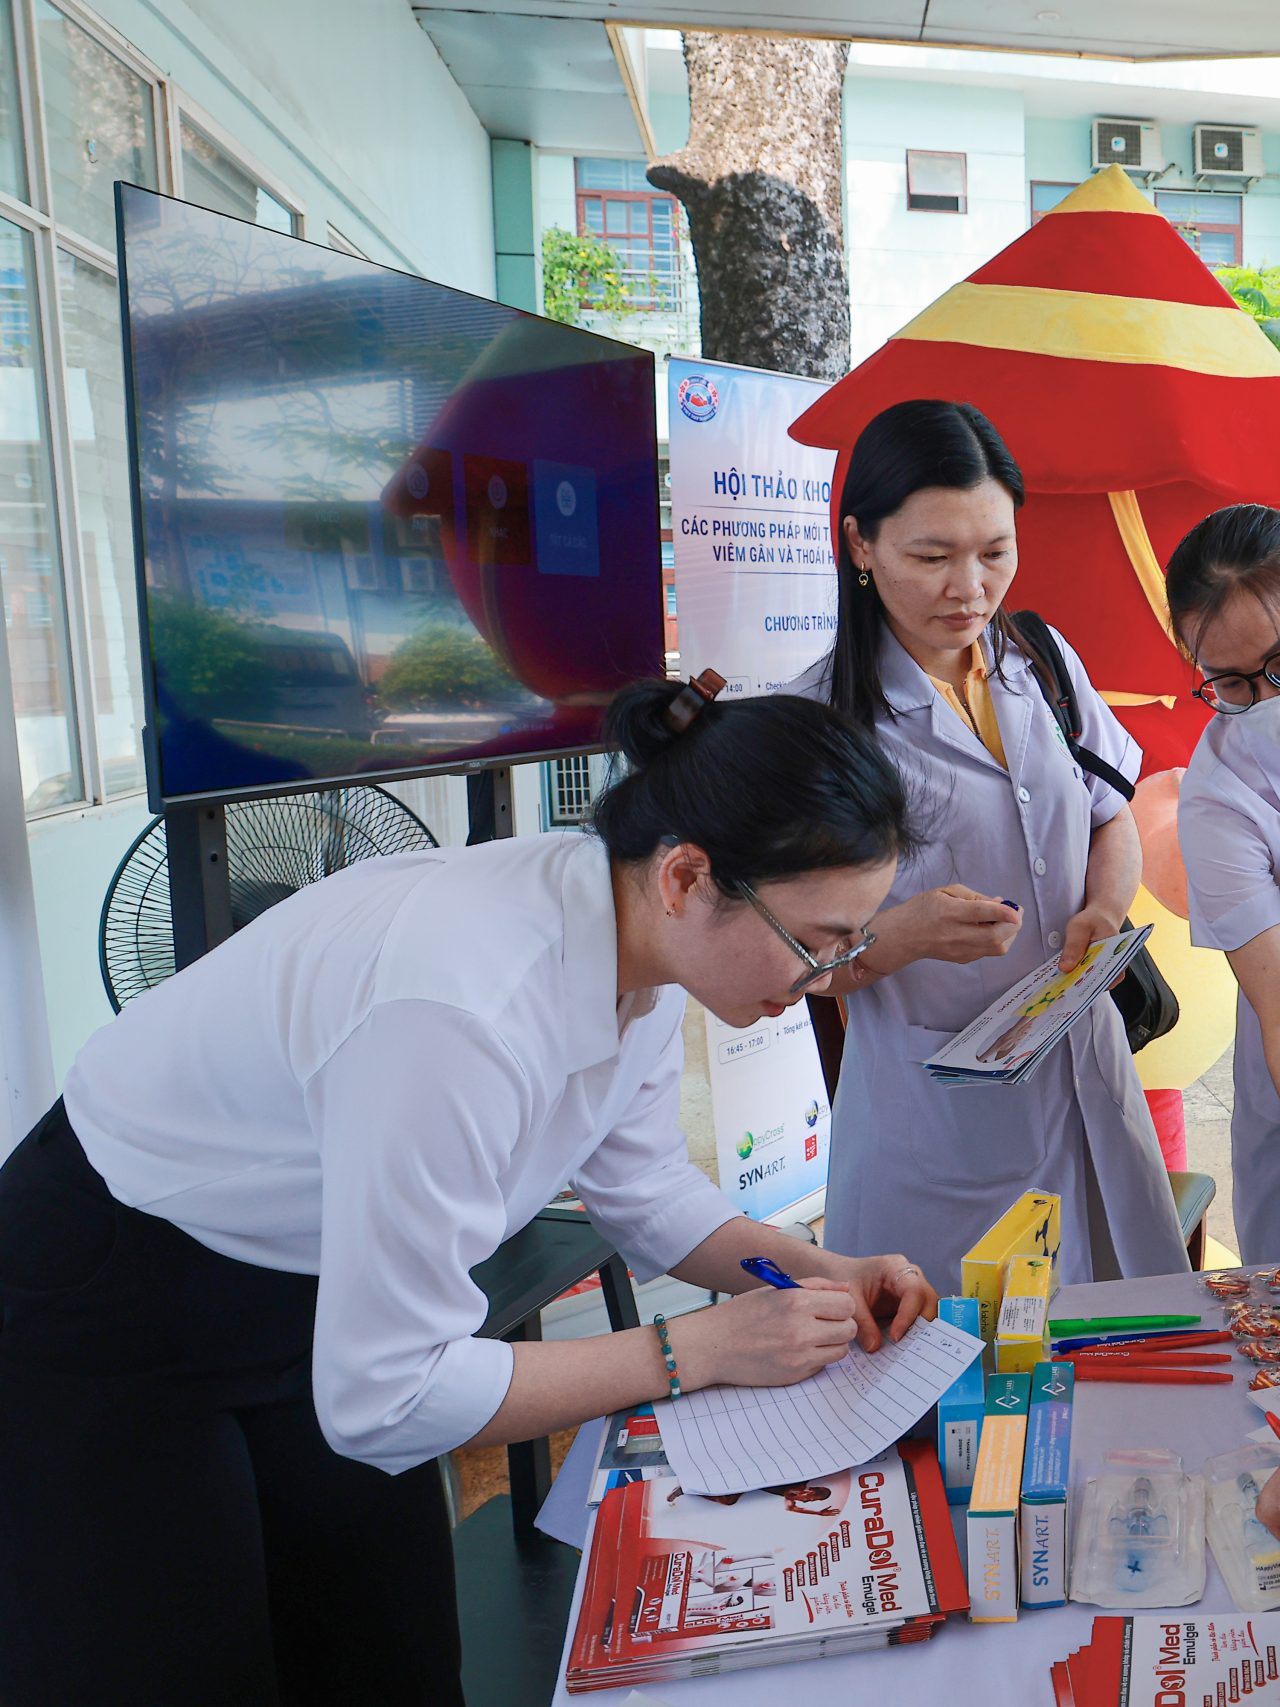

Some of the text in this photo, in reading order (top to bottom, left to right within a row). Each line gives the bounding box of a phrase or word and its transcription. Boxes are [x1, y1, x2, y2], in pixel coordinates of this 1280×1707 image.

[714, 467, 831, 503] HỘI THẢO KHO
[681, 515, 708, 536] CÁC
[713, 520, 766, 538] PHƯƠNG
[769, 520, 800, 540] PHÁP
[803, 524, 821, 542] MỚI
[713, 544, 746, 562] VIÊM
[750, 545, 775, 563] GÂN
[779, 546, 793, 563] VÀ
[796, 547, 825, 565] THOÁI
[765, 615, 810, 632] CHƯƠNG
[726, 684, 743, 693] 14:00
[727, 1043, 743, 1056] 16:45
[749, 1036, 764, 1049] 17:00
[1033, 1515, 1049, 1587] SYNART
[862, 1575, 879, 1616] Emulgel
[877, 1573, 902, 1613] Med
[1159, 1624, 1180, 1665] Med
[1182, 1622, 1199, 1665] Emulgel
